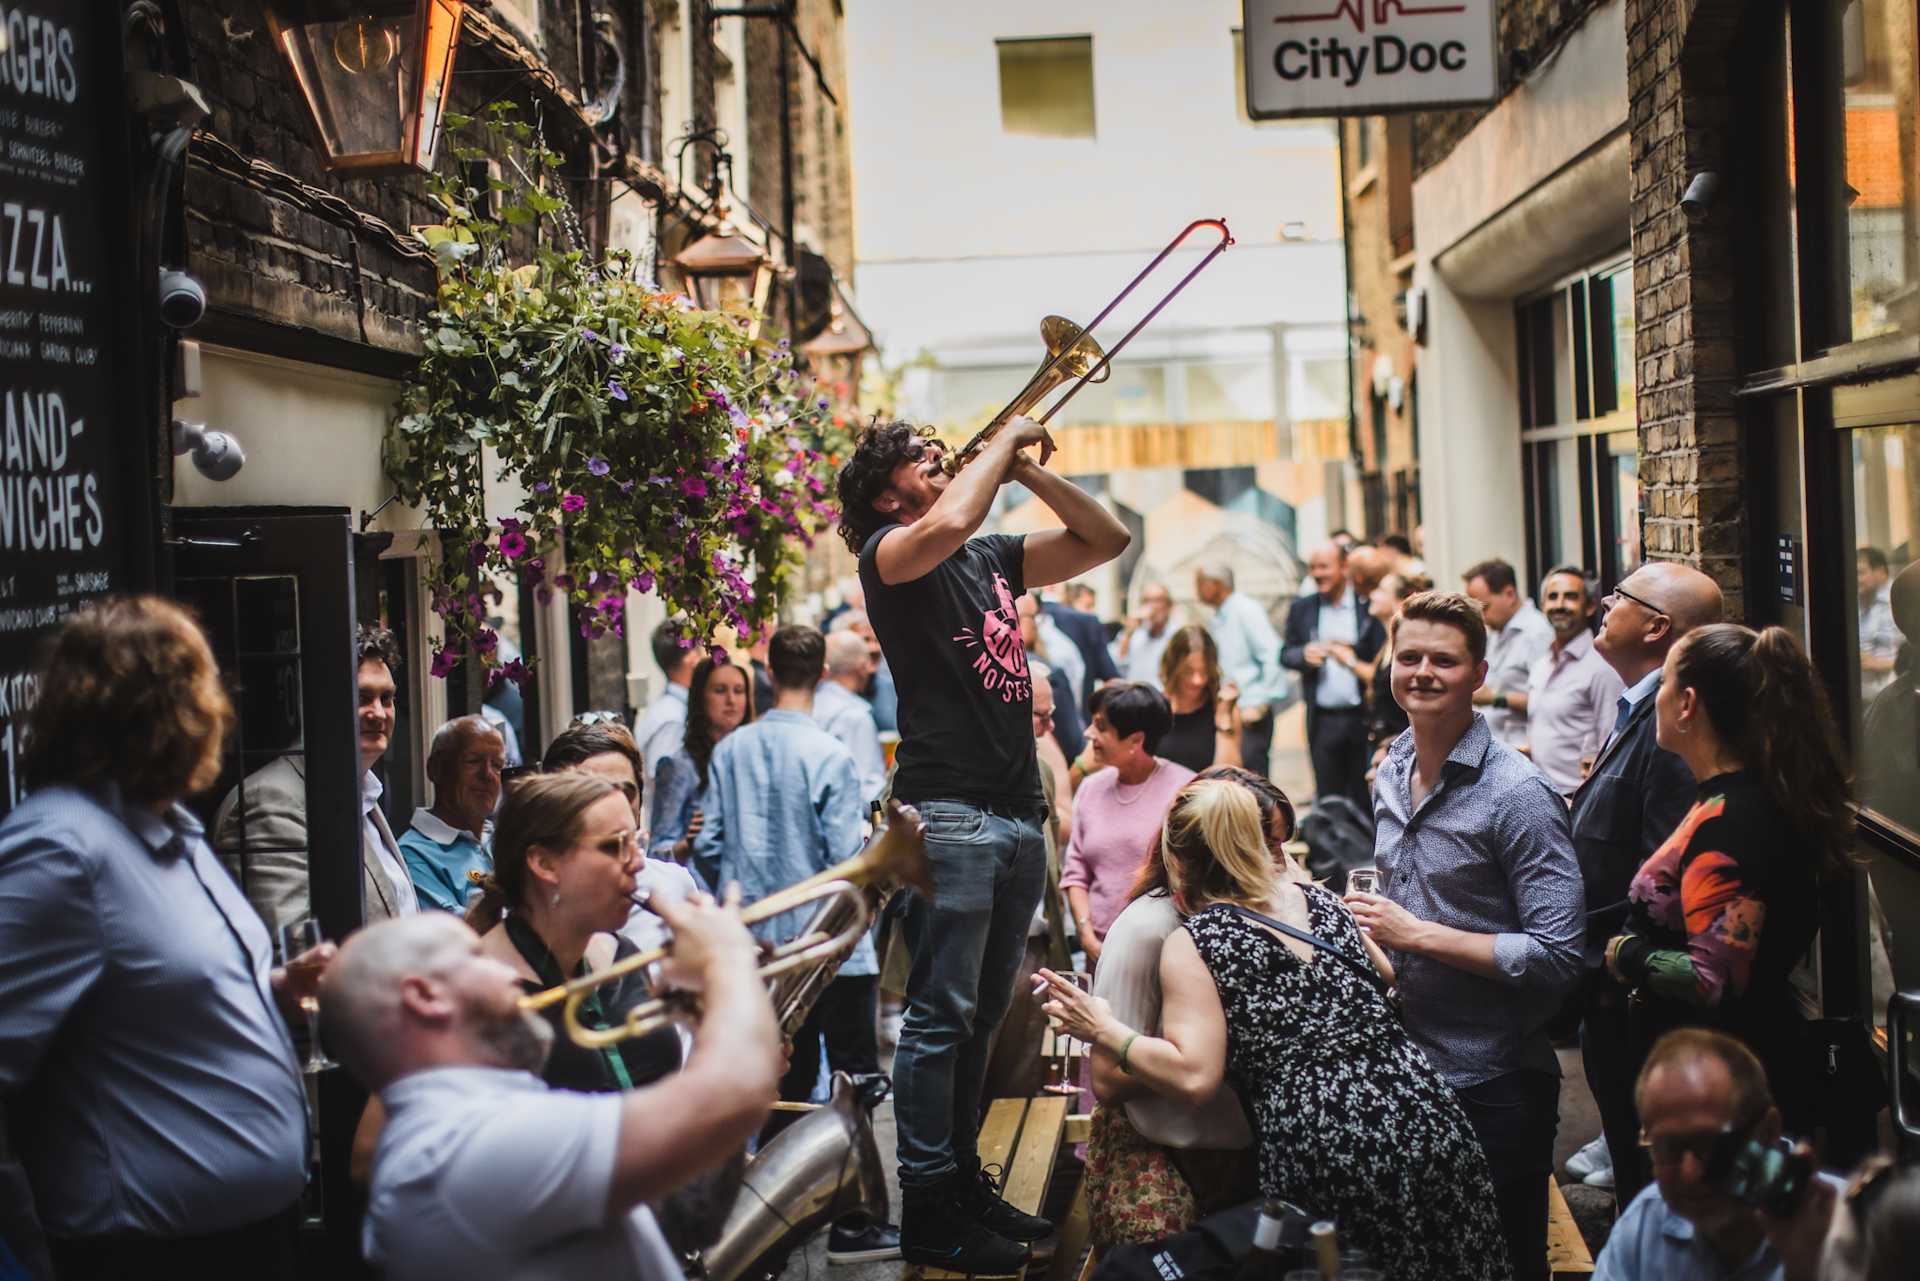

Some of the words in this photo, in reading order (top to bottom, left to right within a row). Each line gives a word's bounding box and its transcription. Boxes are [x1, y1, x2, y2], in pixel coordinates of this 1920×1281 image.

[1273, 36, 1467, 87] CityDoc
[0, 202, 92, 293] ZZA...
[972, 651, 1031, 704] NOISES
